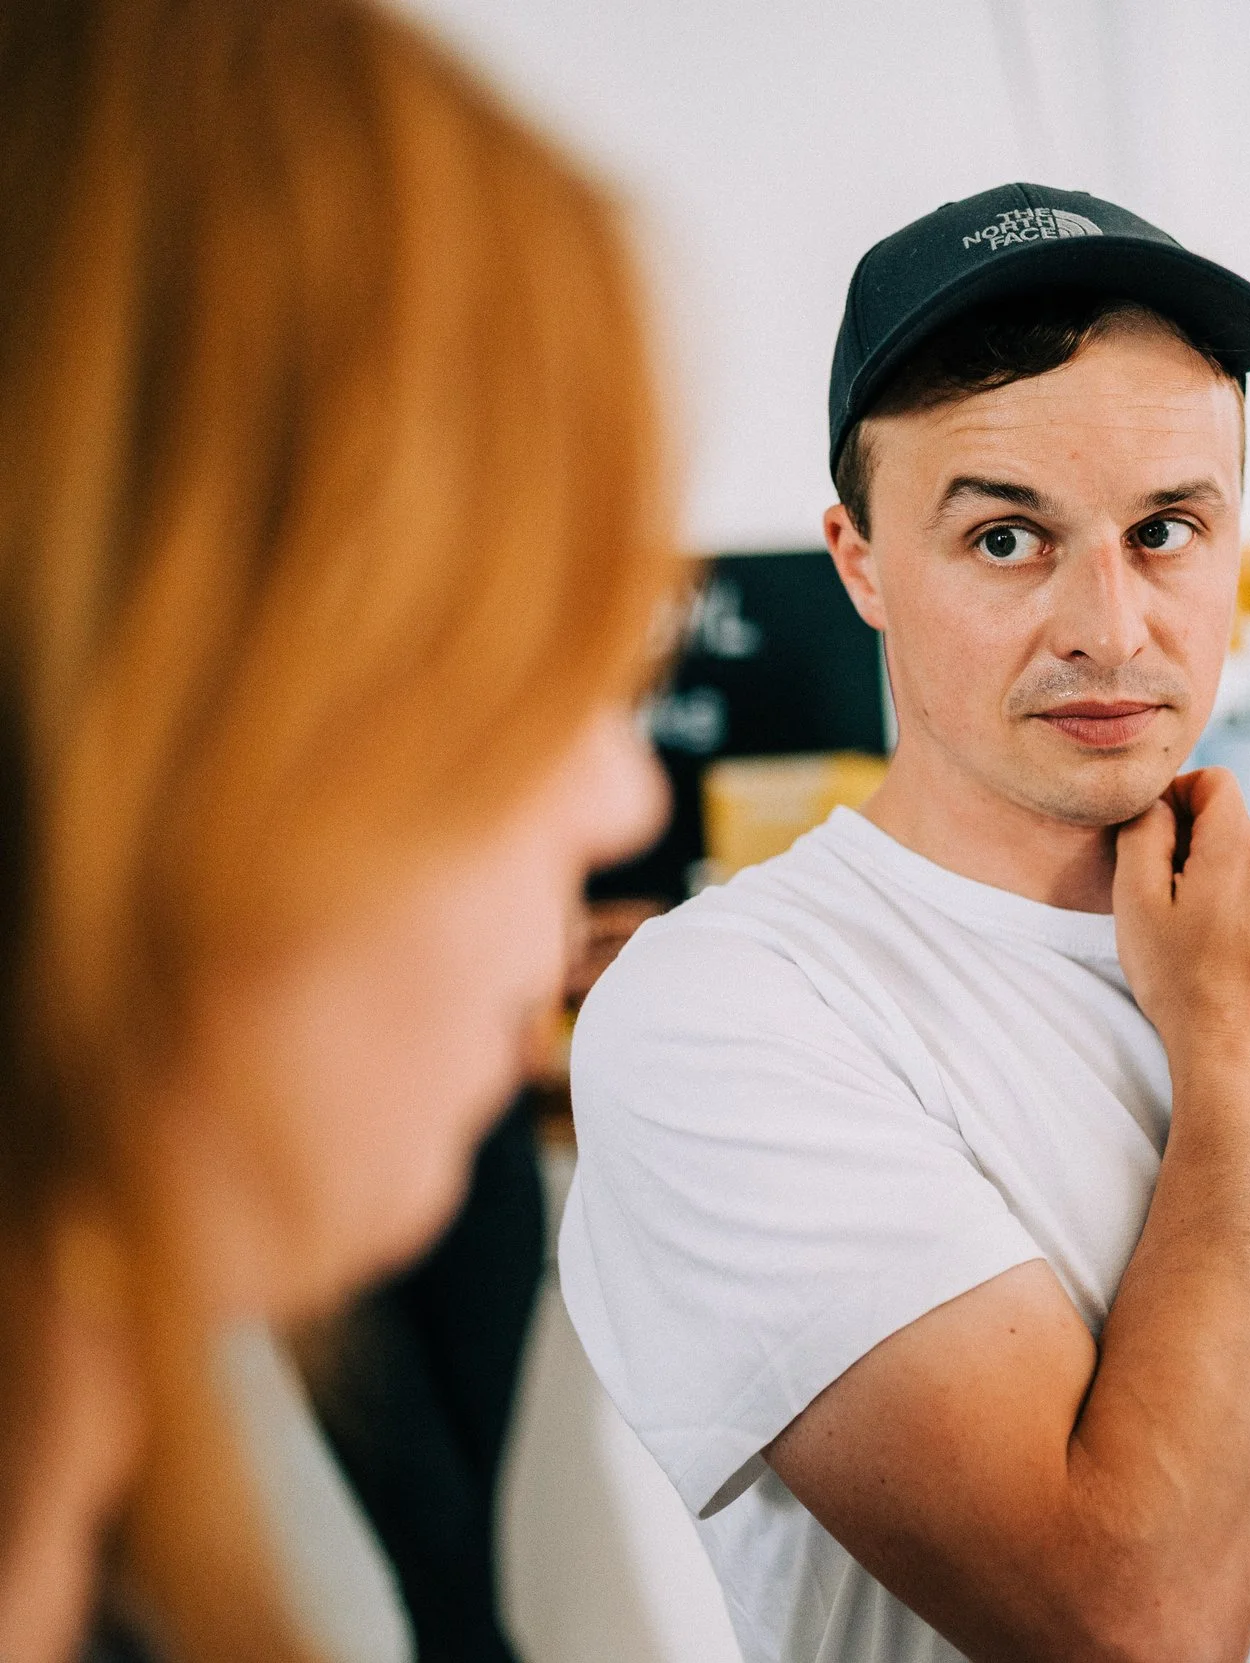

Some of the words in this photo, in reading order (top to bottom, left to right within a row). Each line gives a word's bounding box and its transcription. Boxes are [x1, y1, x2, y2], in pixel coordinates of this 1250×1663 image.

[997, 207, 1051, 222] THE
[962, 216, 1056, 249] NORTH
[990, 227, 1058, 251] FACE
